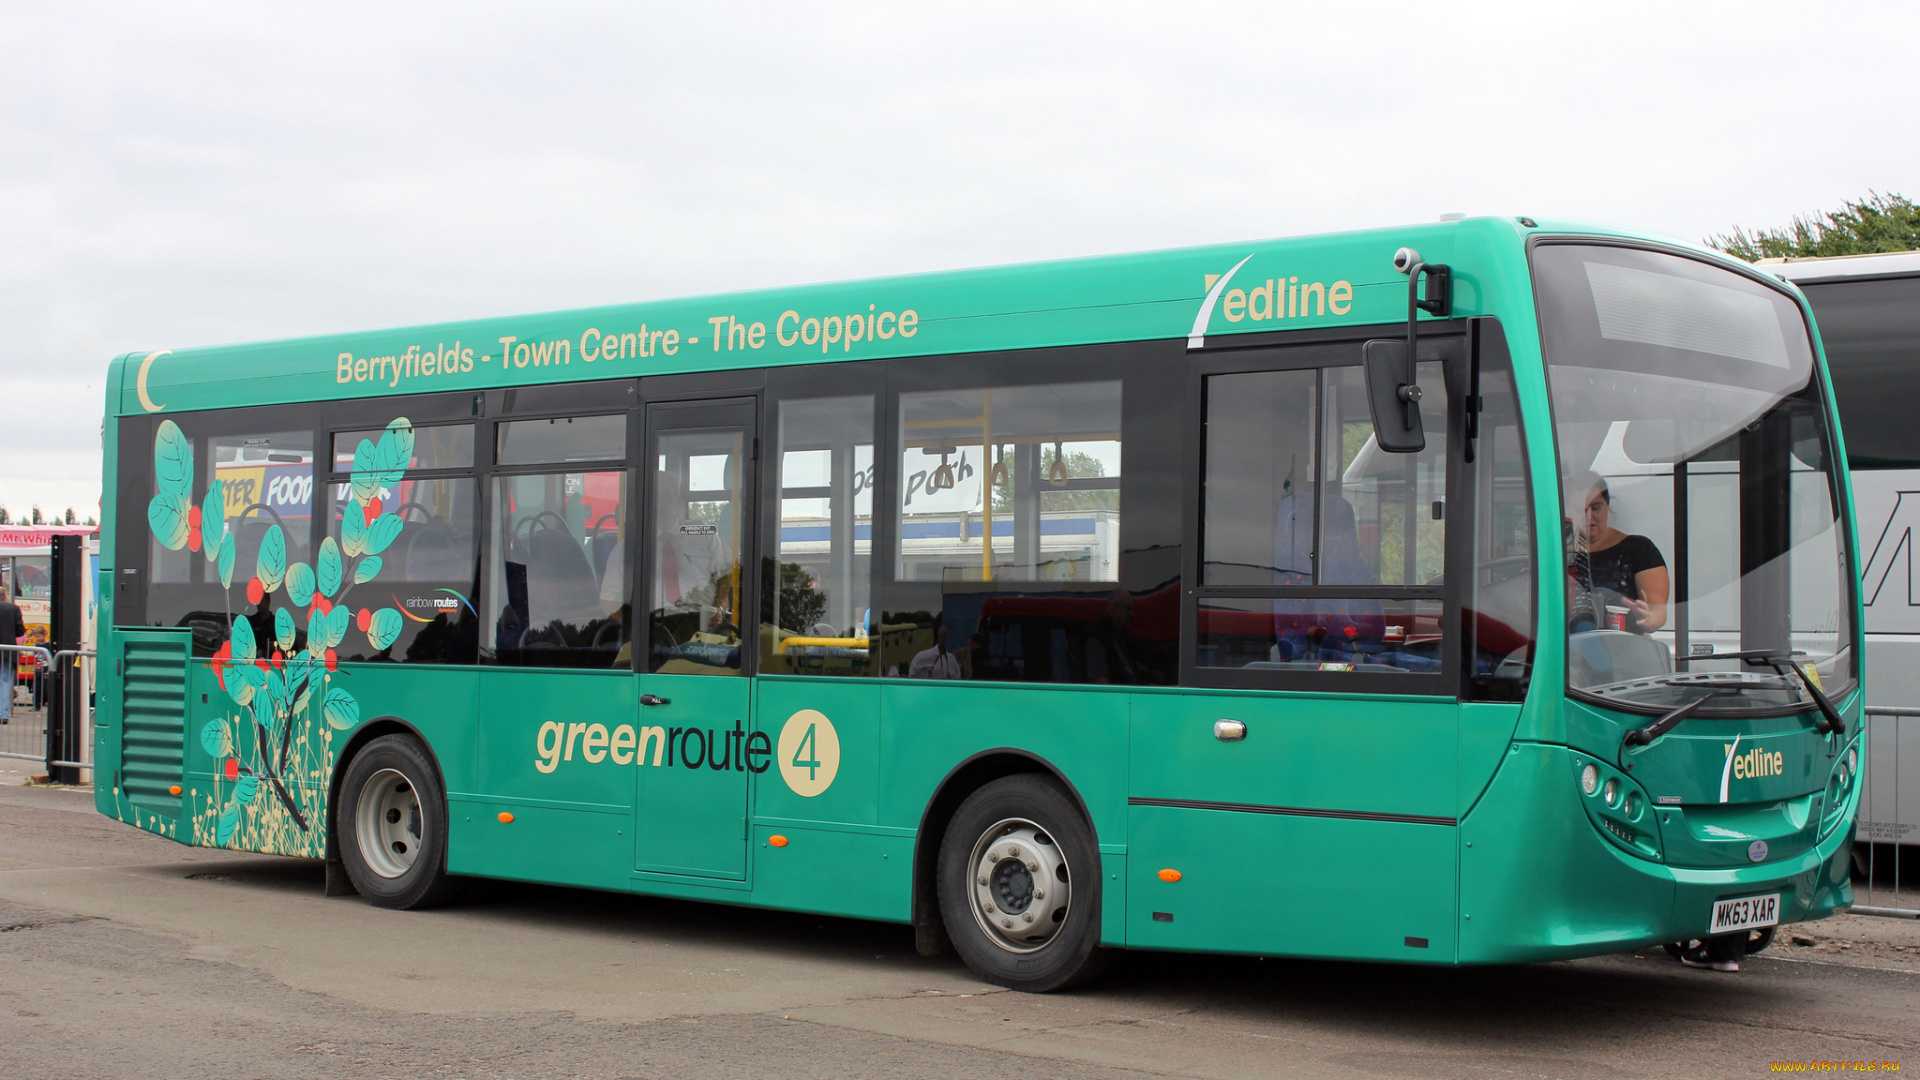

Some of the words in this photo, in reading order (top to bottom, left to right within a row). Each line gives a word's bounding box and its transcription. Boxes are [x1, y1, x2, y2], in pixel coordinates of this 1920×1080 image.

[336, 341, 474, 387] Berryfields
[499, 336, 571, 369] Town
[580, 323, 680, 362] Centre
[708, 315, 766, 352] The
[776, 303, 919, 354] Coppice
[792, 723, 821, 781] 4
[1715, 901, 1750, 928] MK63
[1750, 898, 1776, 923] XAR
